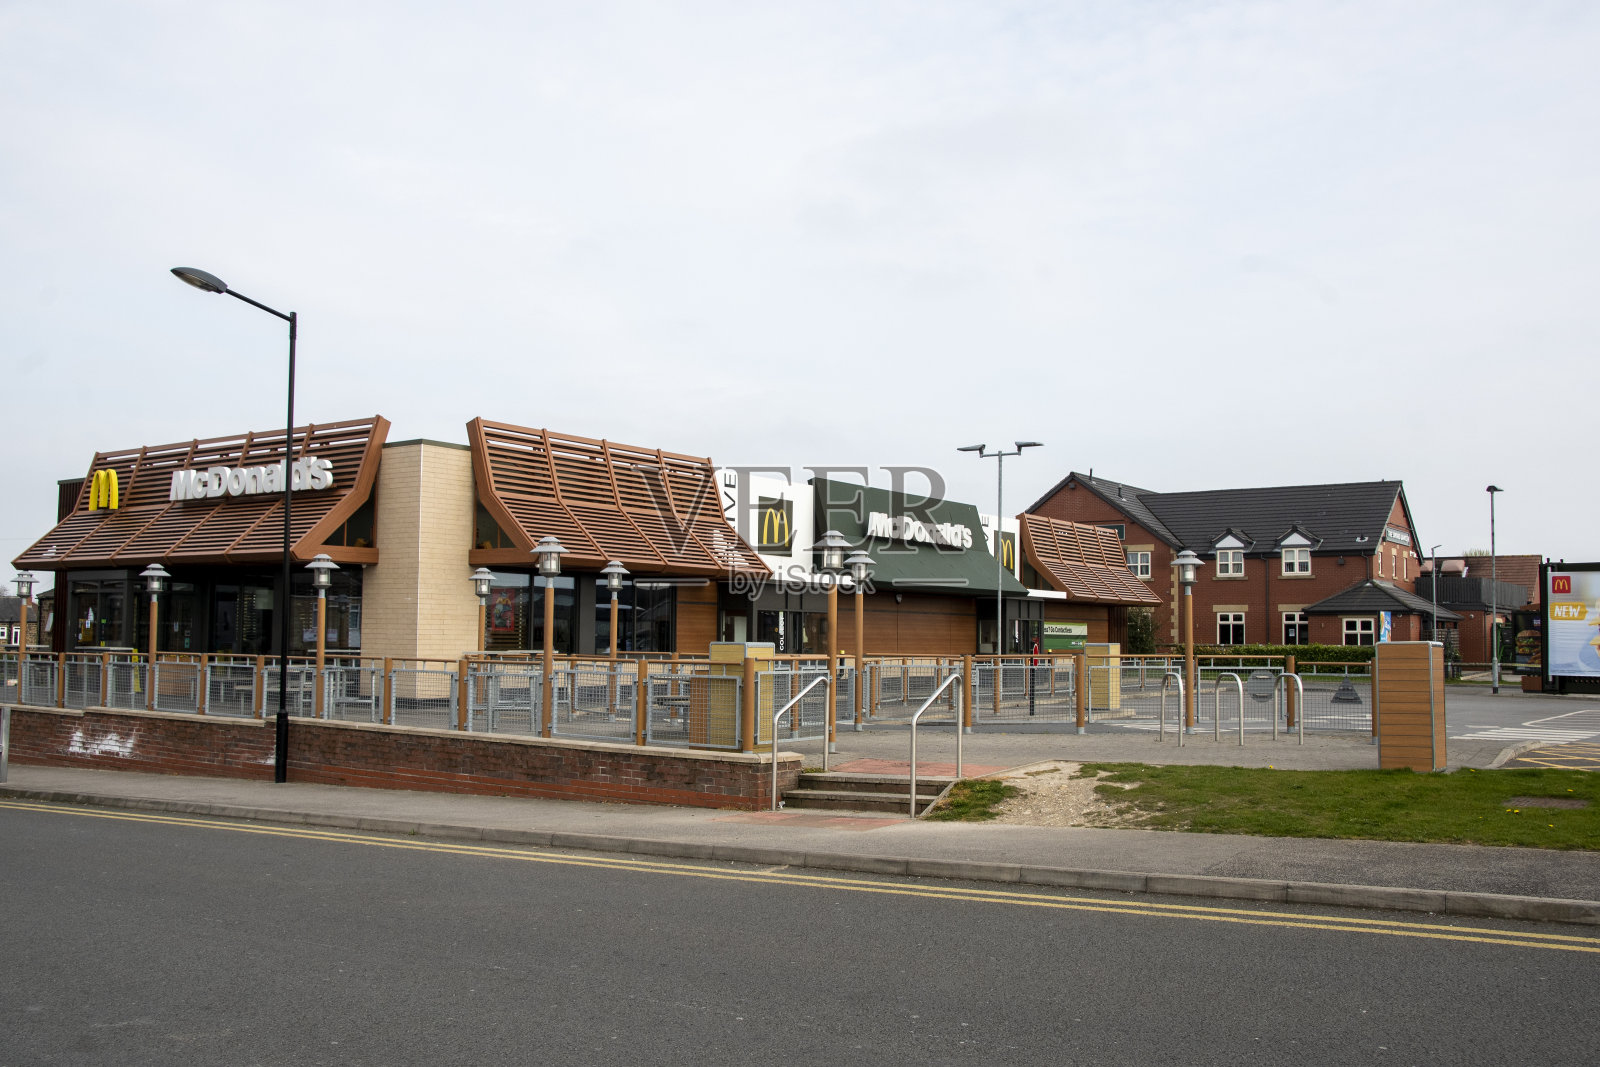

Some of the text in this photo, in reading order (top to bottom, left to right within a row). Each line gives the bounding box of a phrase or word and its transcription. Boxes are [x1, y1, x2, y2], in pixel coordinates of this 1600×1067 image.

[170, 456, 333, 501] McDonald's
[868, 512, 972, 548] McDonald's
[1554, 605, 1580, 617] NEW
